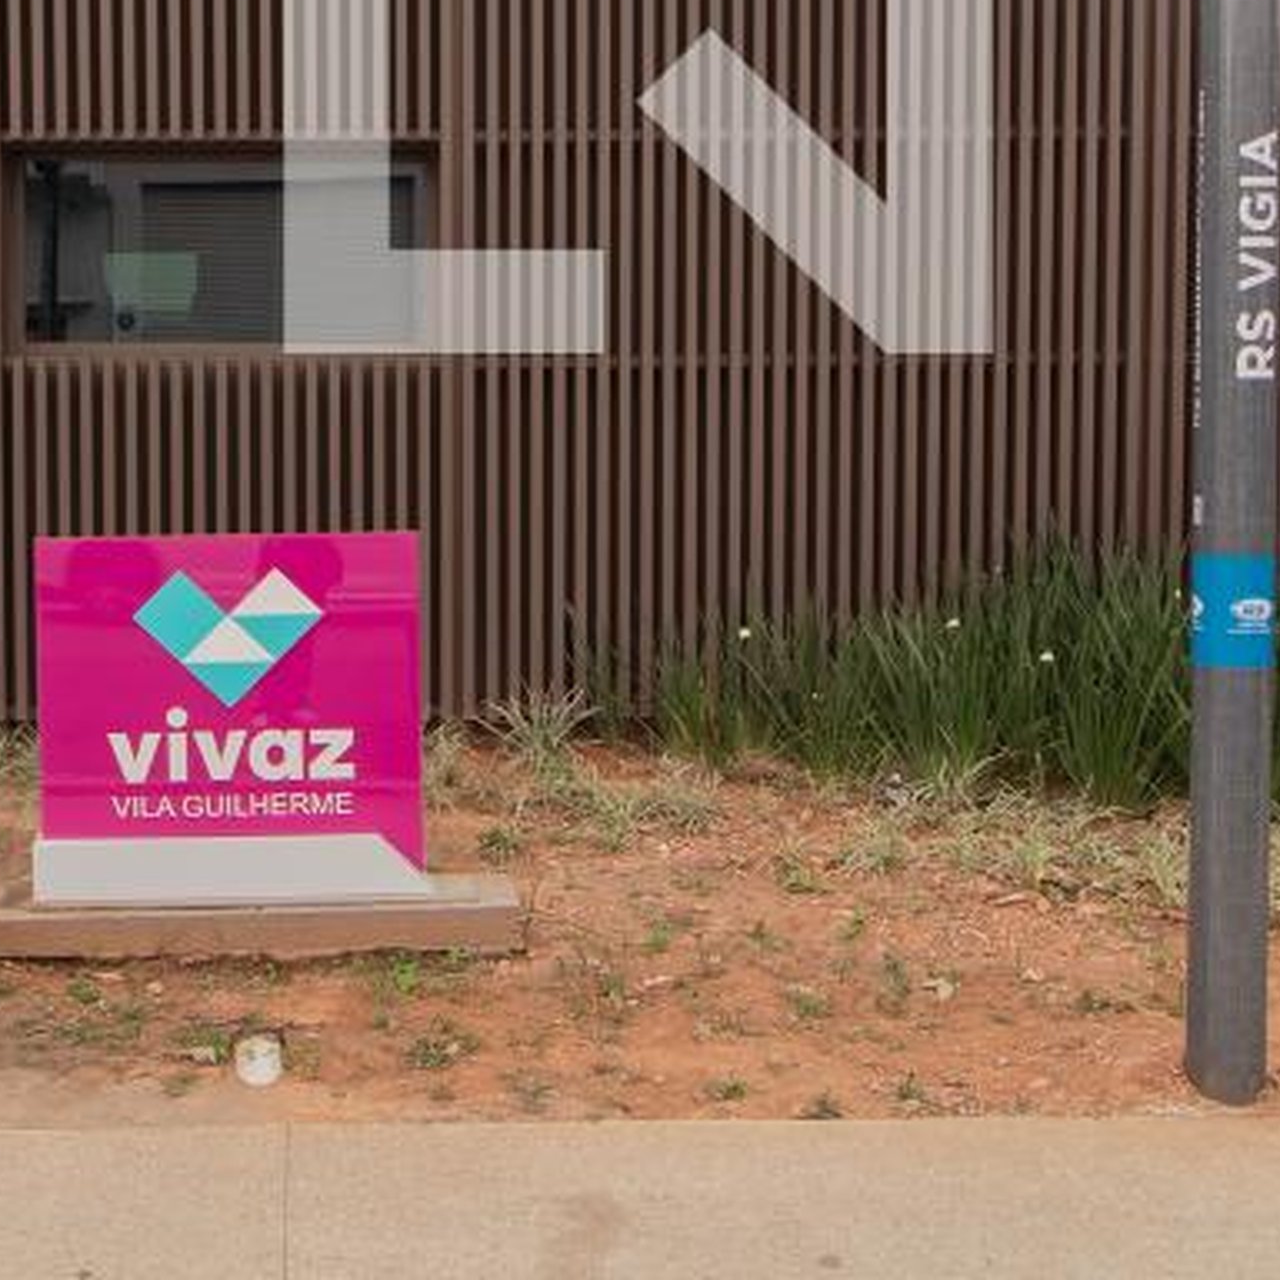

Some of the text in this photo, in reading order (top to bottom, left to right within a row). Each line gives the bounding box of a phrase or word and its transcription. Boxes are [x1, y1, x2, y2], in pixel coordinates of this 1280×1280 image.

[1236, 131, 1279, 380] RS VIGIA
[107, 707, 356, 784] vivaz
[111, 792, 355, 819] VILA GUILHERME
